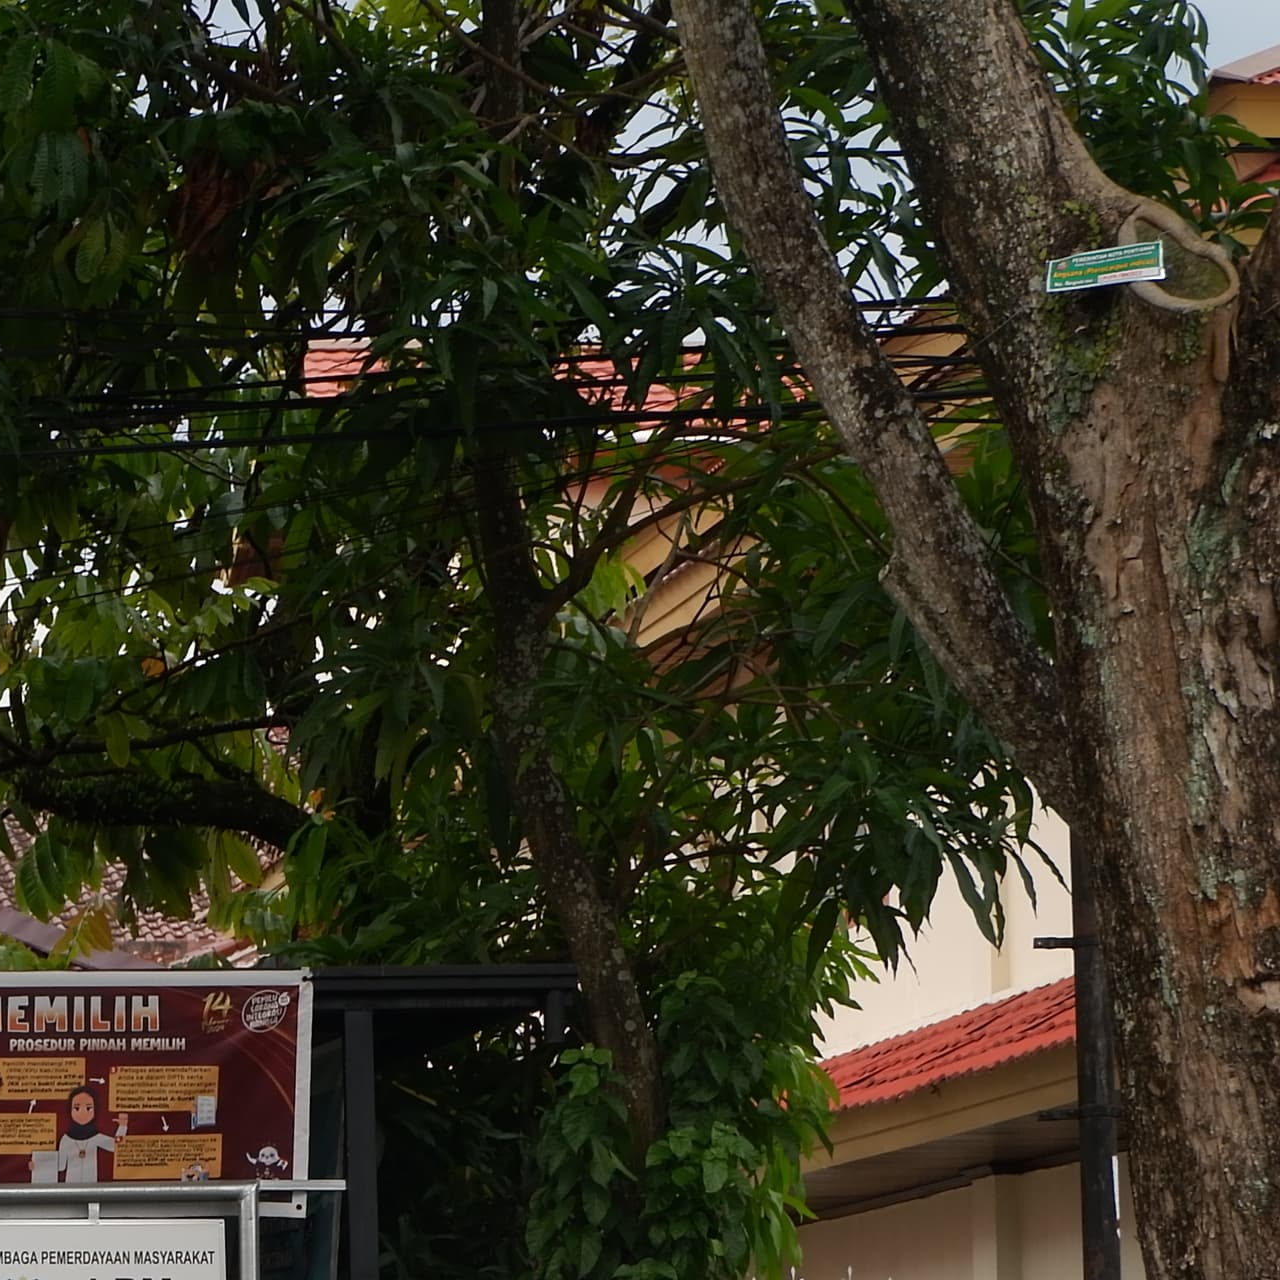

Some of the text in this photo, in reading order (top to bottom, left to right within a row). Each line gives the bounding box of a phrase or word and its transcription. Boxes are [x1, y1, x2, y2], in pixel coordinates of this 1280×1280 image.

[9, 1037, 185, 1051] PROSEDUR PINDAH MEMILIH
[41, 1250, 130, 1264] PEMERDAYAAN
[133, 1250, 215, 1264] MASYARAKAT
